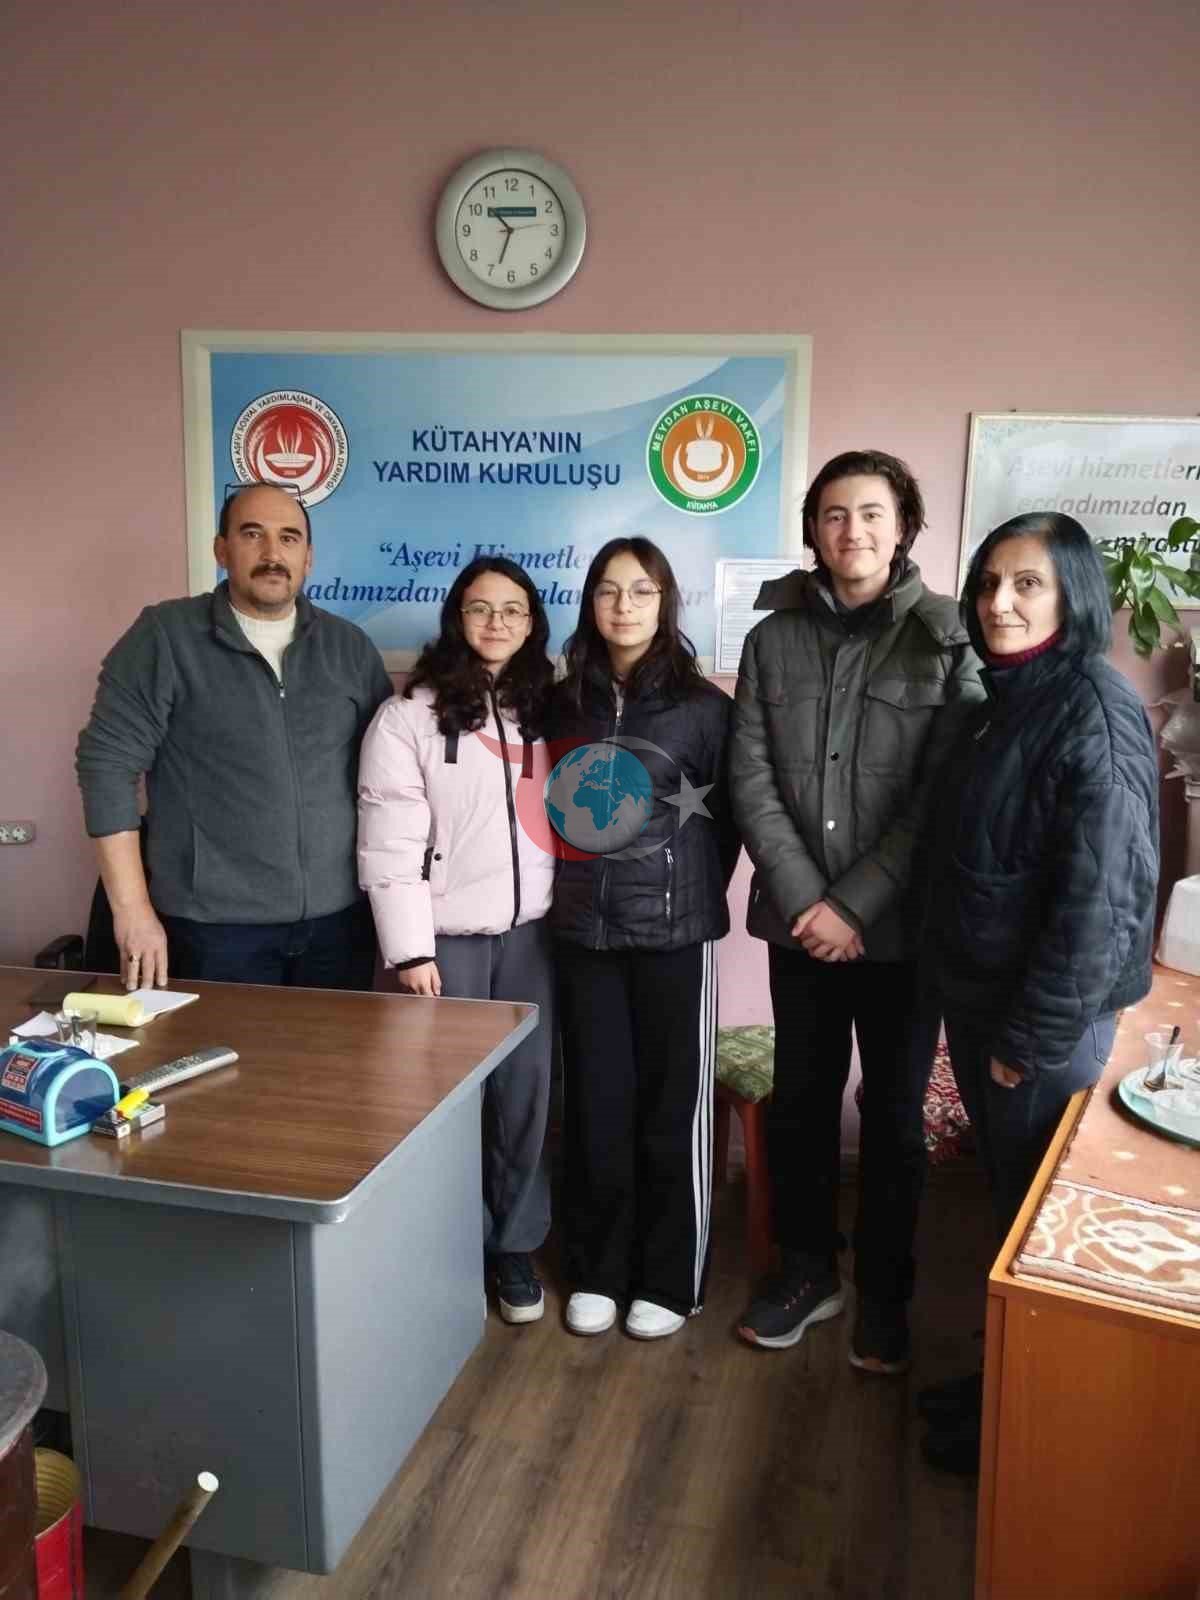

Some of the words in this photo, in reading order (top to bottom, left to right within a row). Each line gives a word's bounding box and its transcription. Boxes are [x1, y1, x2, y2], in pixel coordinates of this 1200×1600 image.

[504, 178, 519, 191] 12
[483, 187, 496, 198] 11
[529, 185, 535, 199] 1
[468, 203, 482, 216] 10
[545, 201, 553, 213] 2
[462, 224, 471, 237] 9
[550, 224, 559, 236] 3
[470, 249, 478, 261] 8
[544, 248, 552, 259] 4
[488, 264, 495, 276] 7
[507, 270, 516, 283] 6
[530, 264, 538, 276] 5
[652, 404, 688, 452] MEYDAN
[694, 399, 732, 416] AŞEVİ
[736, 413, 756, 452] VAKFI
[412, 425, 581, 453] KÜTAHYA’NIN
[373, 461, 469, 483] YARDIM
[479, 463, 621, 490] KURULUŞU
